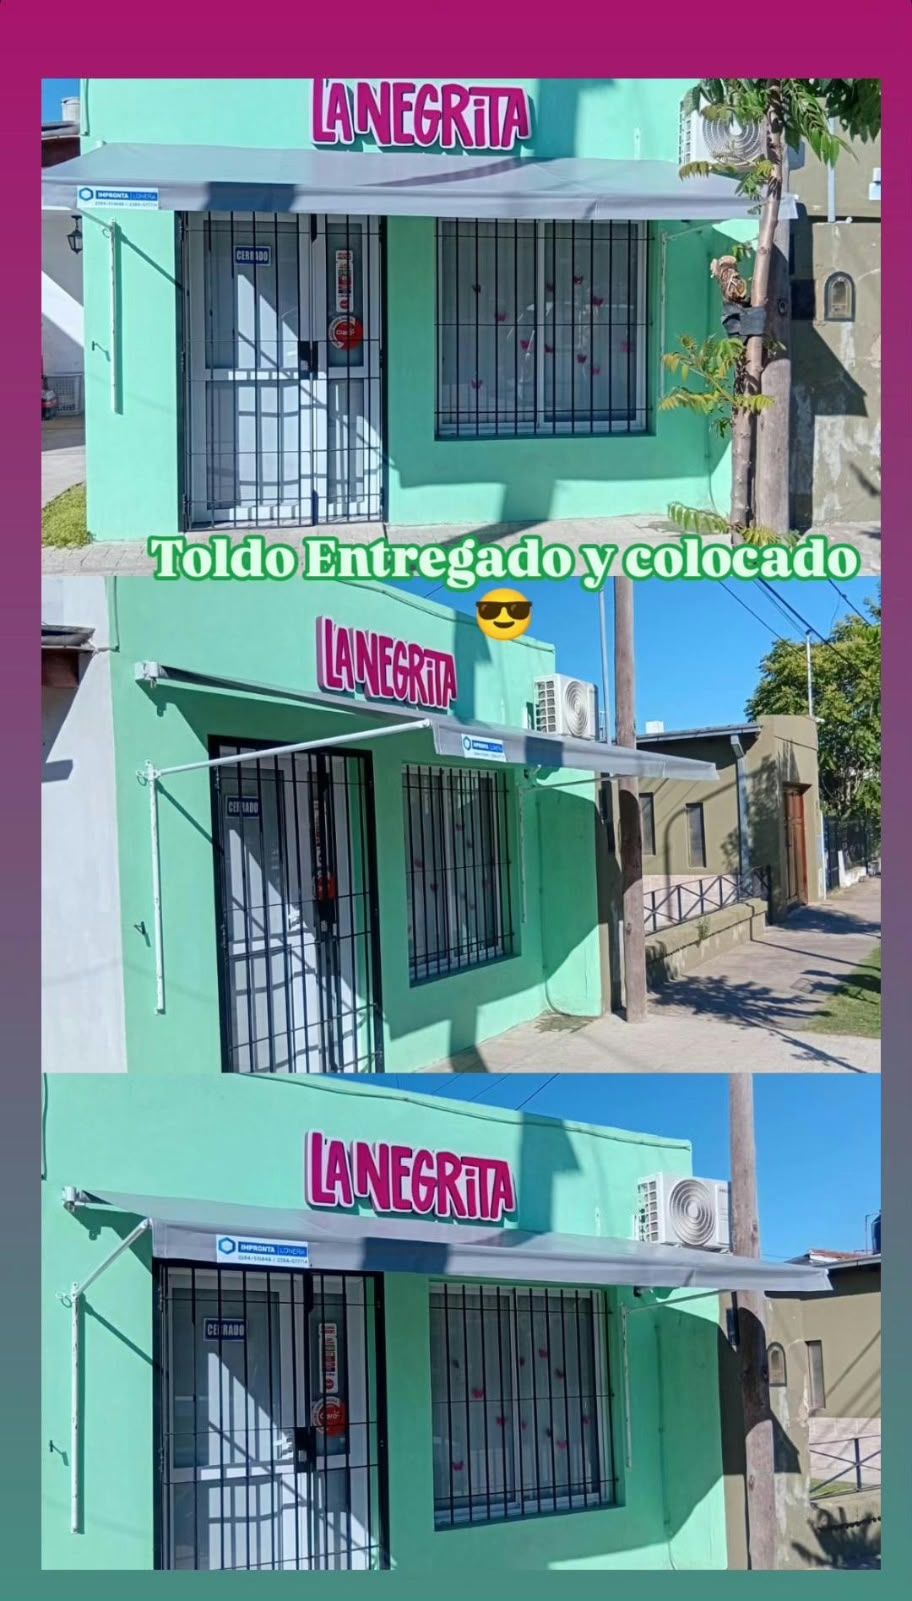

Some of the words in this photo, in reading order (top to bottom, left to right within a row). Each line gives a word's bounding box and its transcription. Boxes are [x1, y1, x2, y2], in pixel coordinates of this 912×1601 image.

[97, 191, 129, 199] IMPRONTA
[240, 1243, 276, 1254] IMPRONTA
[207, 1324, 245, 1336] CERADO
